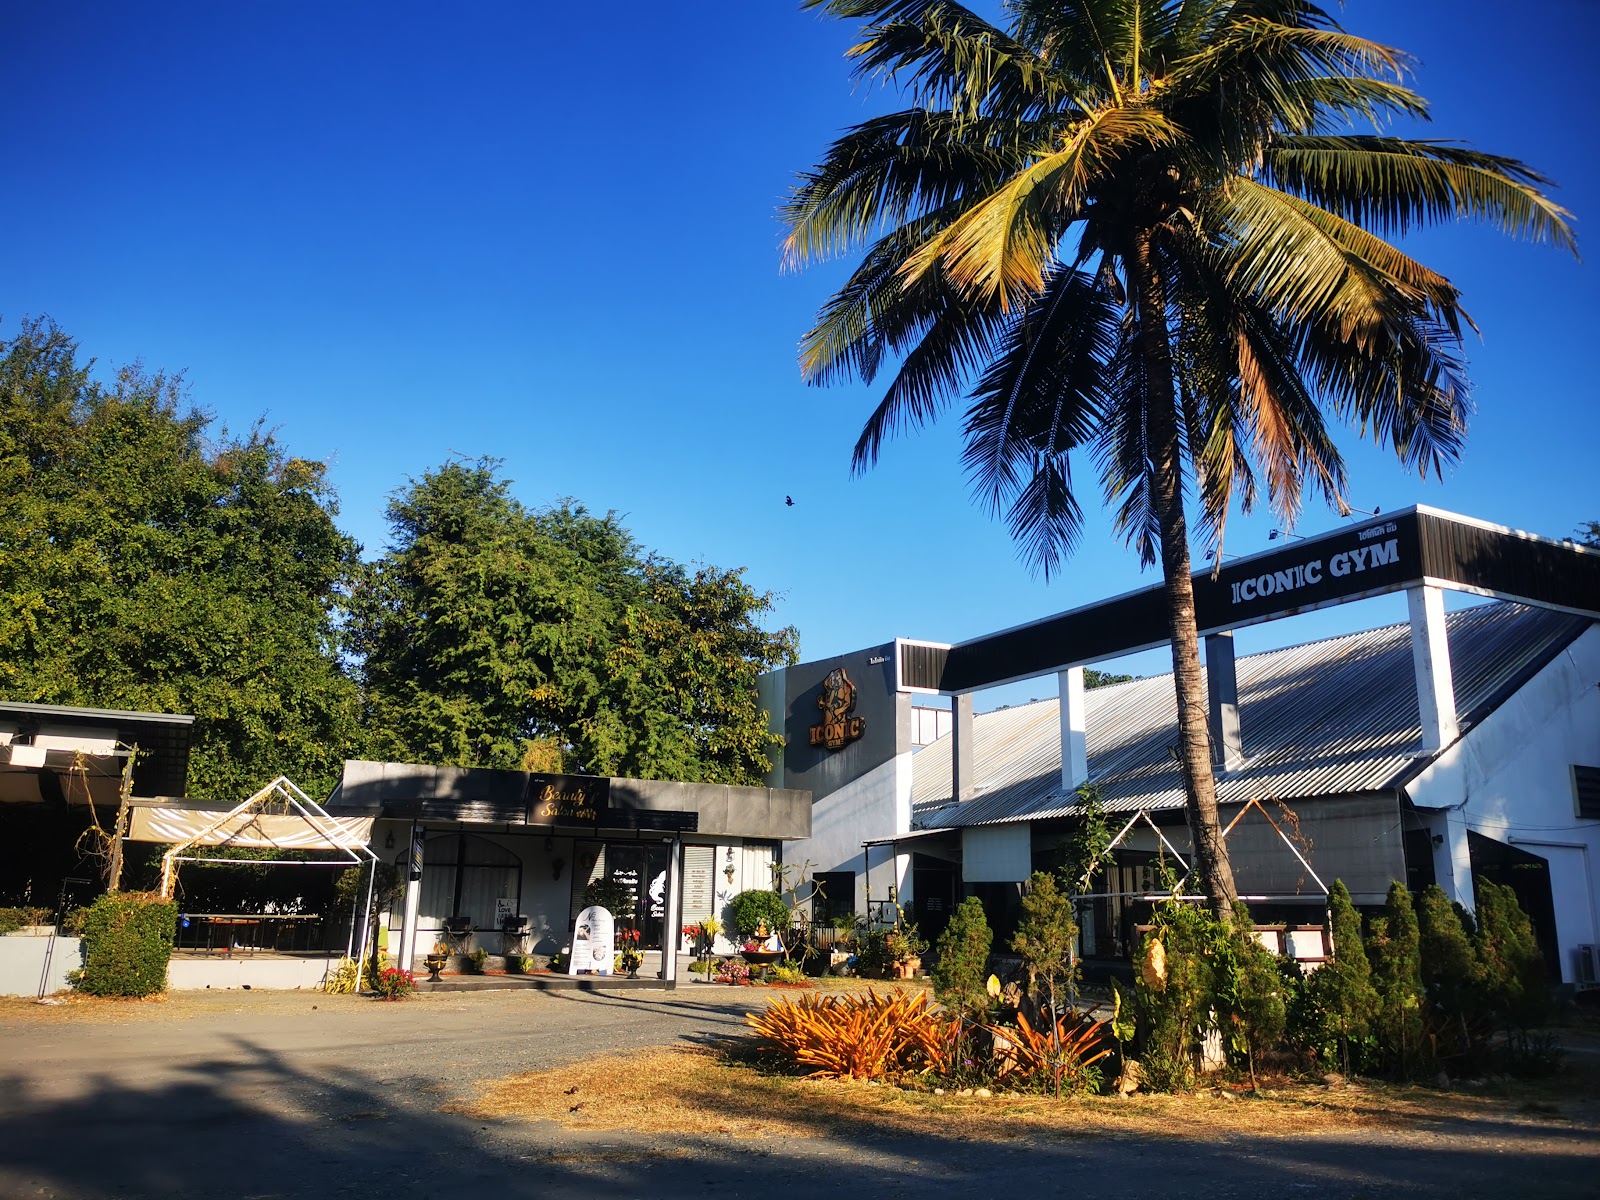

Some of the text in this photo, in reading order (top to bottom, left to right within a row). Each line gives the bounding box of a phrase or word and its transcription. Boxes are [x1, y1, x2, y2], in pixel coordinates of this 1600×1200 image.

[1231, 538, 1399, 604] ICONIC GYM
[809, 719, 860, 745] ICONIC
[539, 784, 586, 806] Beauty
